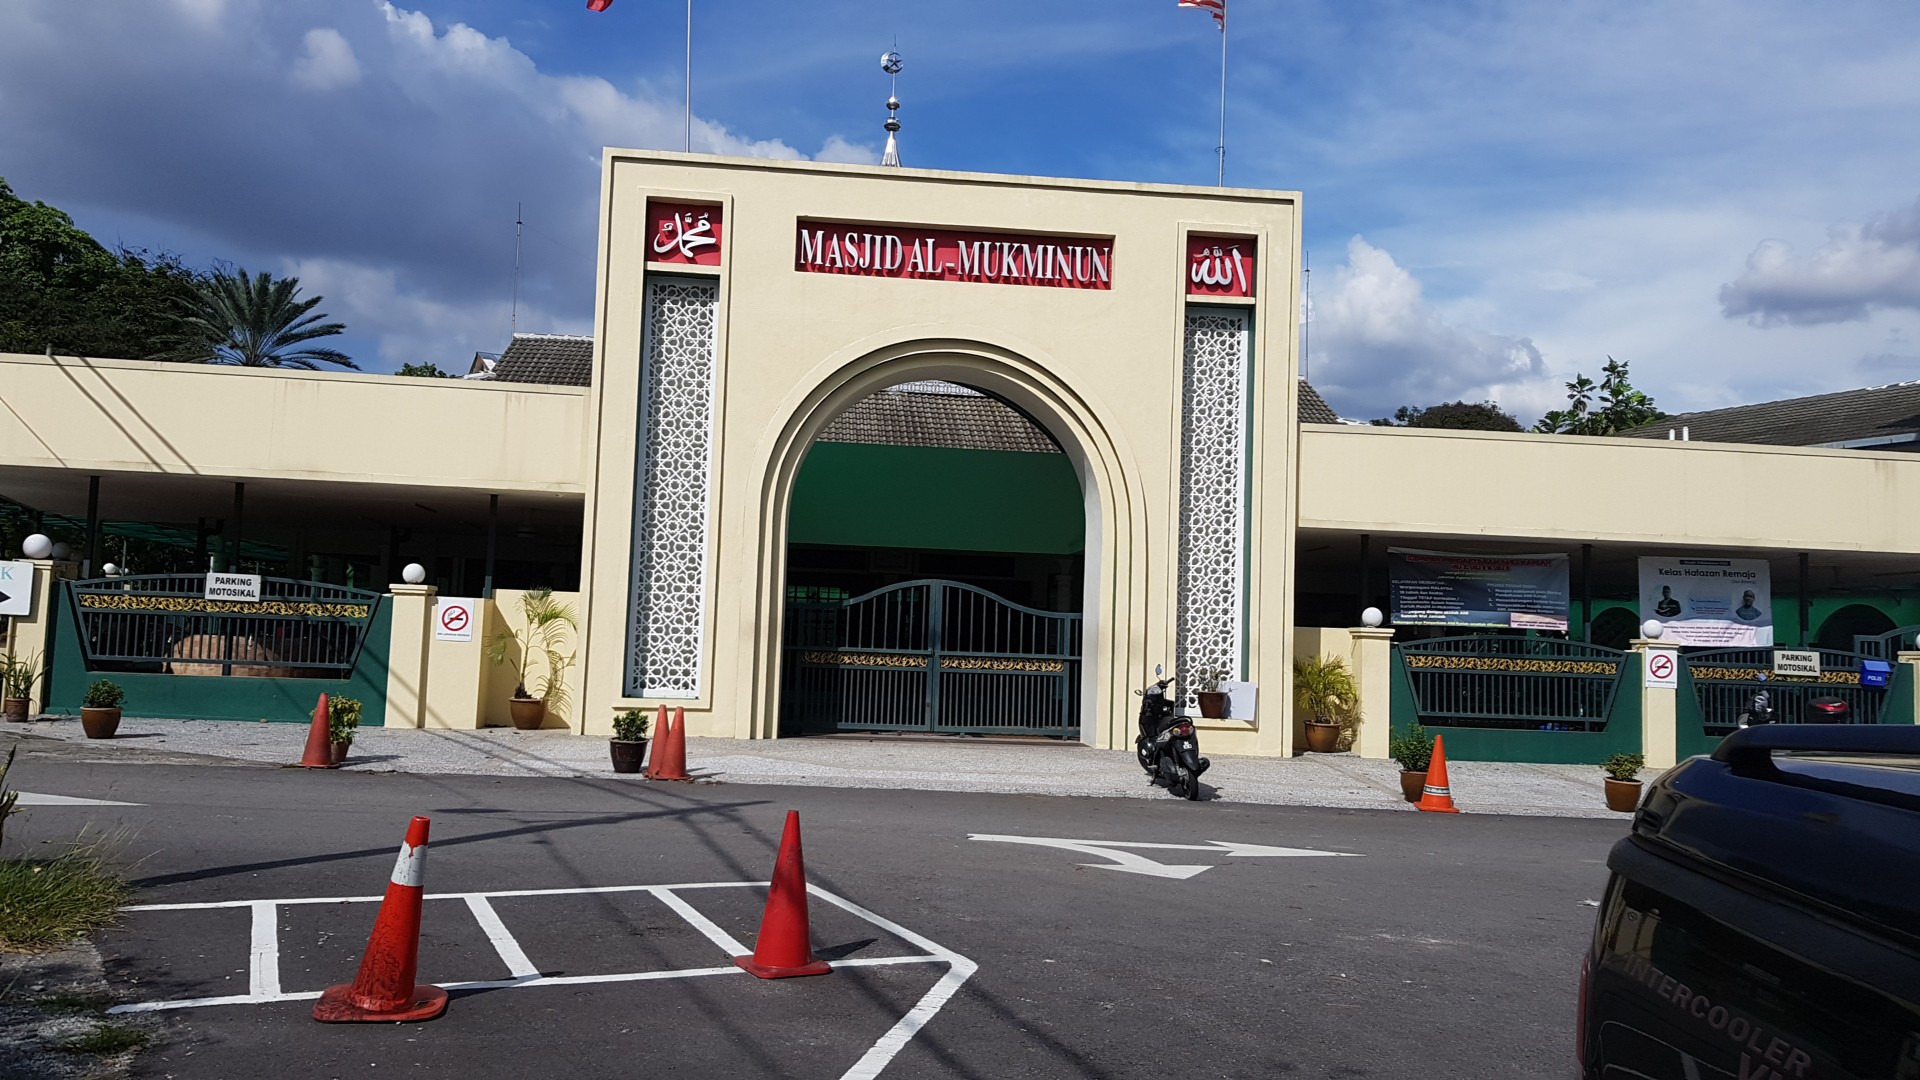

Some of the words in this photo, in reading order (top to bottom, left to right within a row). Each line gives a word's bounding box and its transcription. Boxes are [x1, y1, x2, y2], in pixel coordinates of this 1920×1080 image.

[800, 229, 903, 270] MASJID
[1658, 568, 1682, 576] Kelas
[1685, 569, 1720, 577] Hafazan
[1723, 570, 1756, 579] Remaja
[215, 577, 252, 586] PARKING
[209, 587, 256, 597] MOTOSIKAL
[1781, 653, 1813, 662] PARKING
[1777, 663, 1817, 672] MOTOSIKAL
[1623, 956, 1812, 1079] INTERCOOLER
